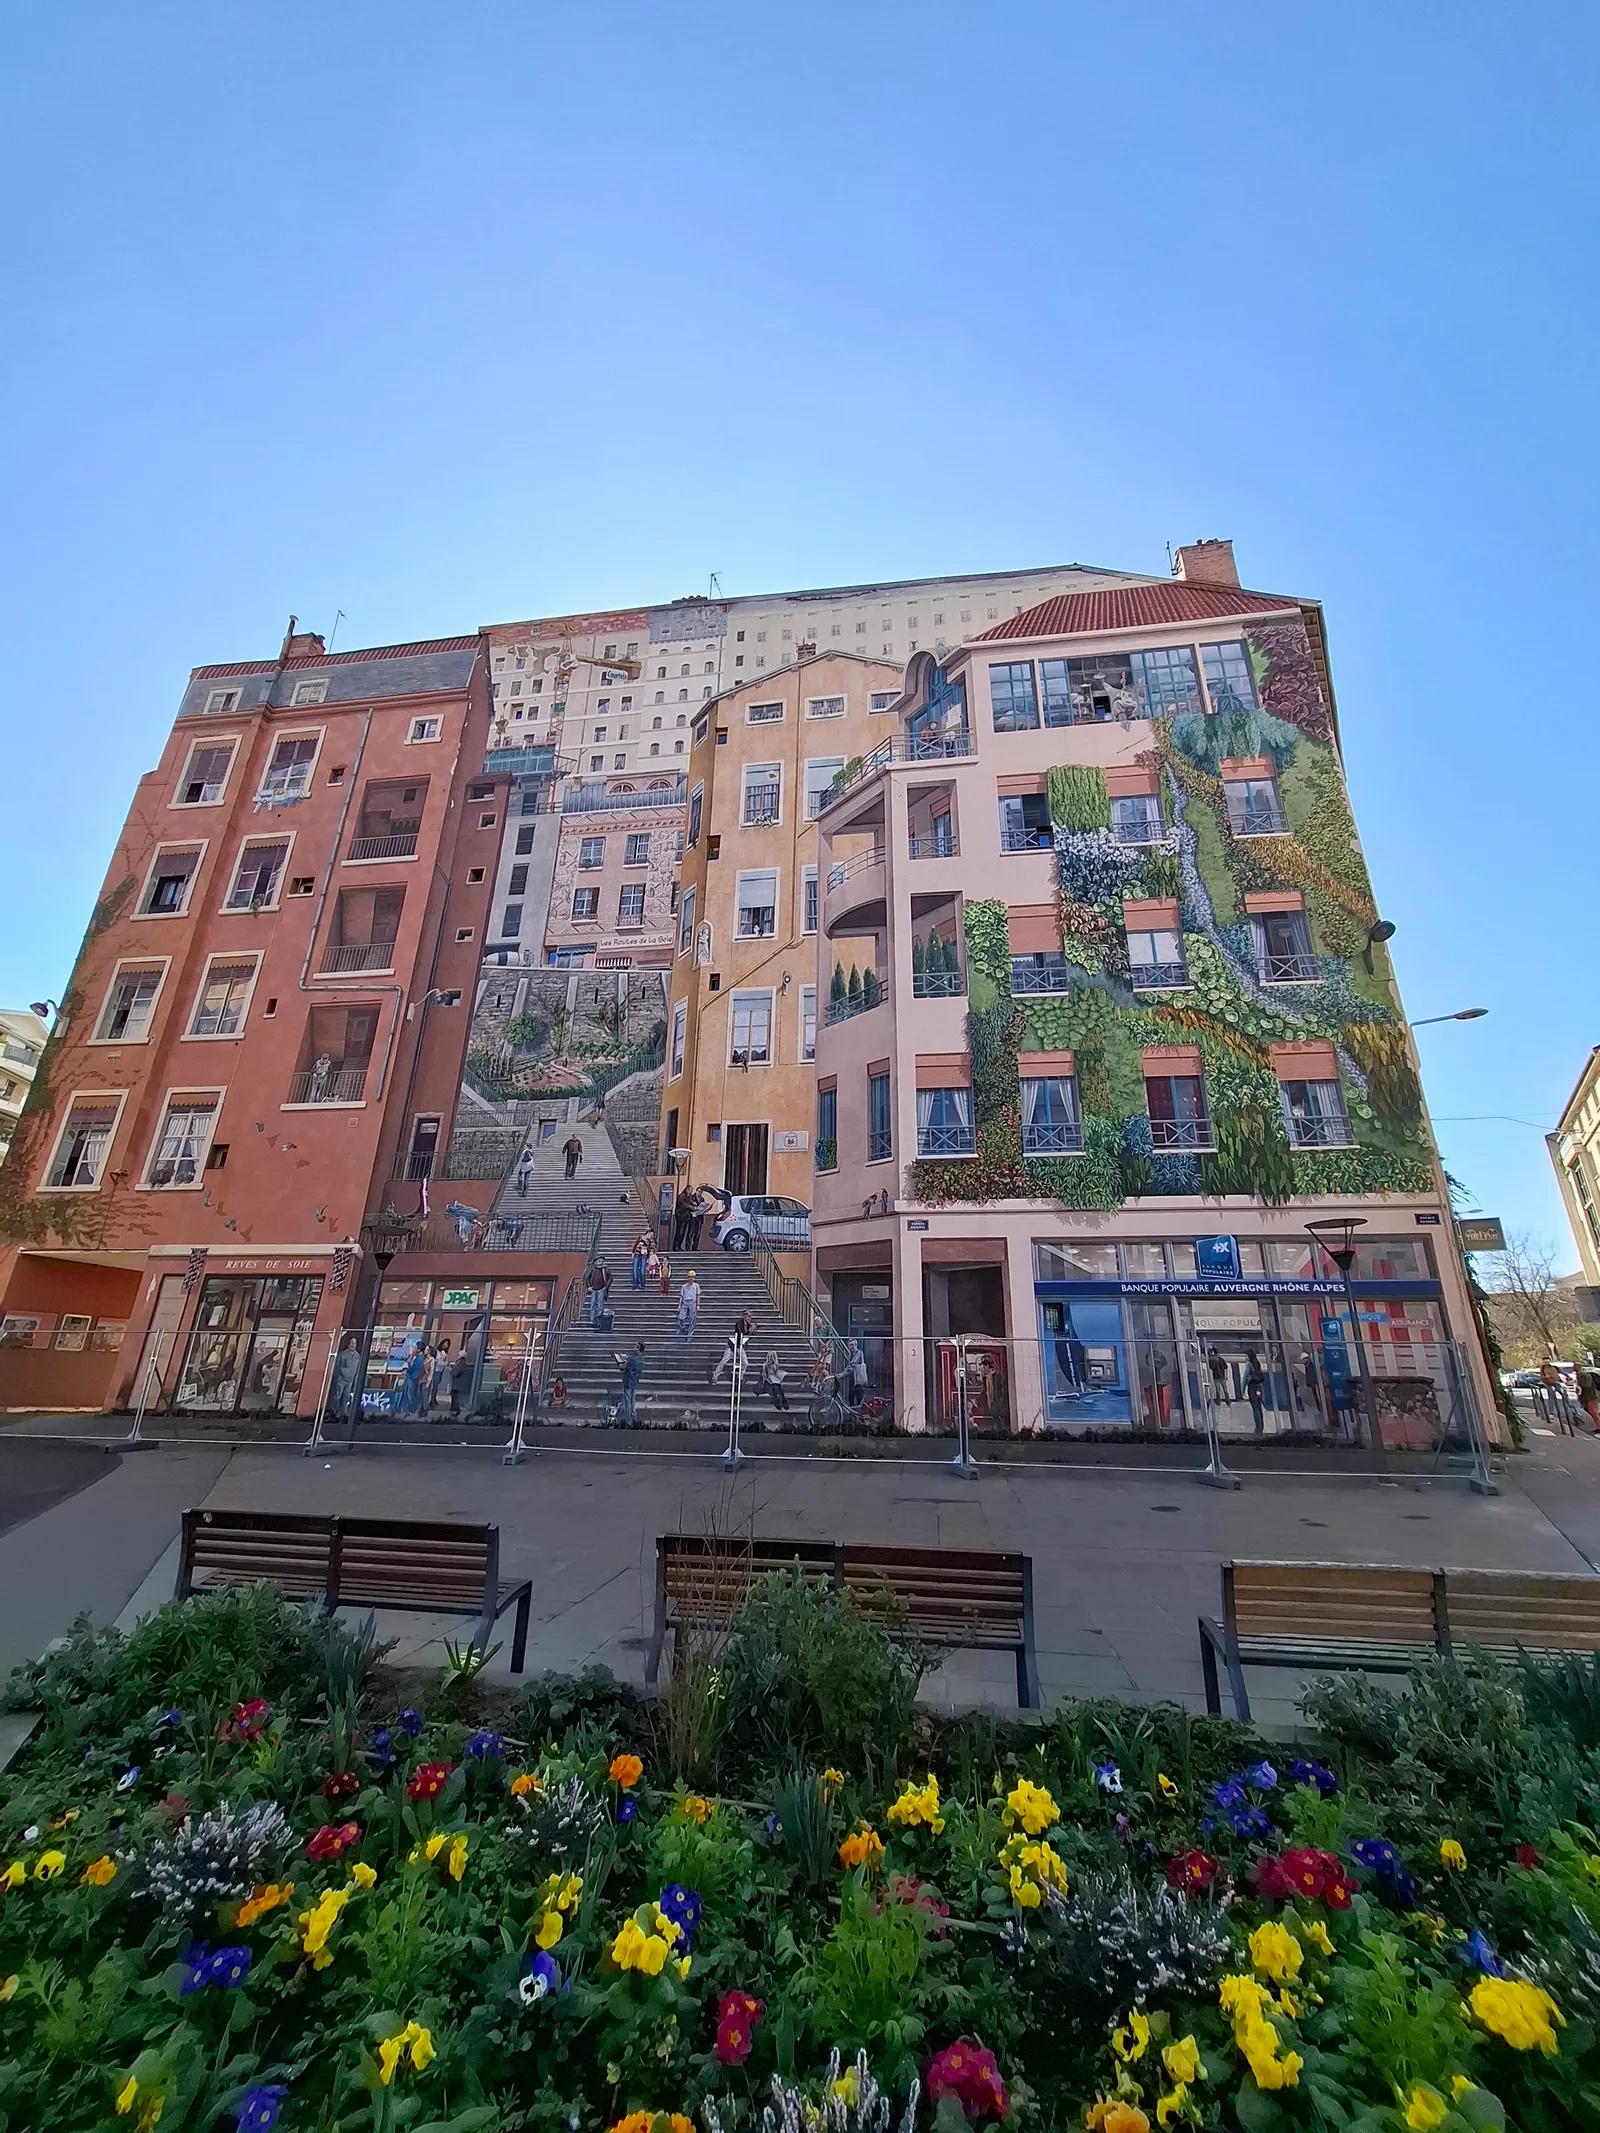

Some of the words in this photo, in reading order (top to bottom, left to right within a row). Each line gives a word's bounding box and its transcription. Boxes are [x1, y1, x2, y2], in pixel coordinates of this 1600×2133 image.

[225, 1260, 258, 1269] REVES
[265, 1260, 280, 1269] DE
[287, 1260, 312, 1269] SOIE
[1121, 1284, 1159, 1293] BANQUE
[1161, 1284, 1210, 1292] POPULAIRE
[1213, 1284, 1270, 1292] AUVERGNE
[1272, 1282, 1310, 1292] RHÔNE
[1312, 1284, 1346, 1292] ALPES
[911, 1348, 916, 1357] 3
